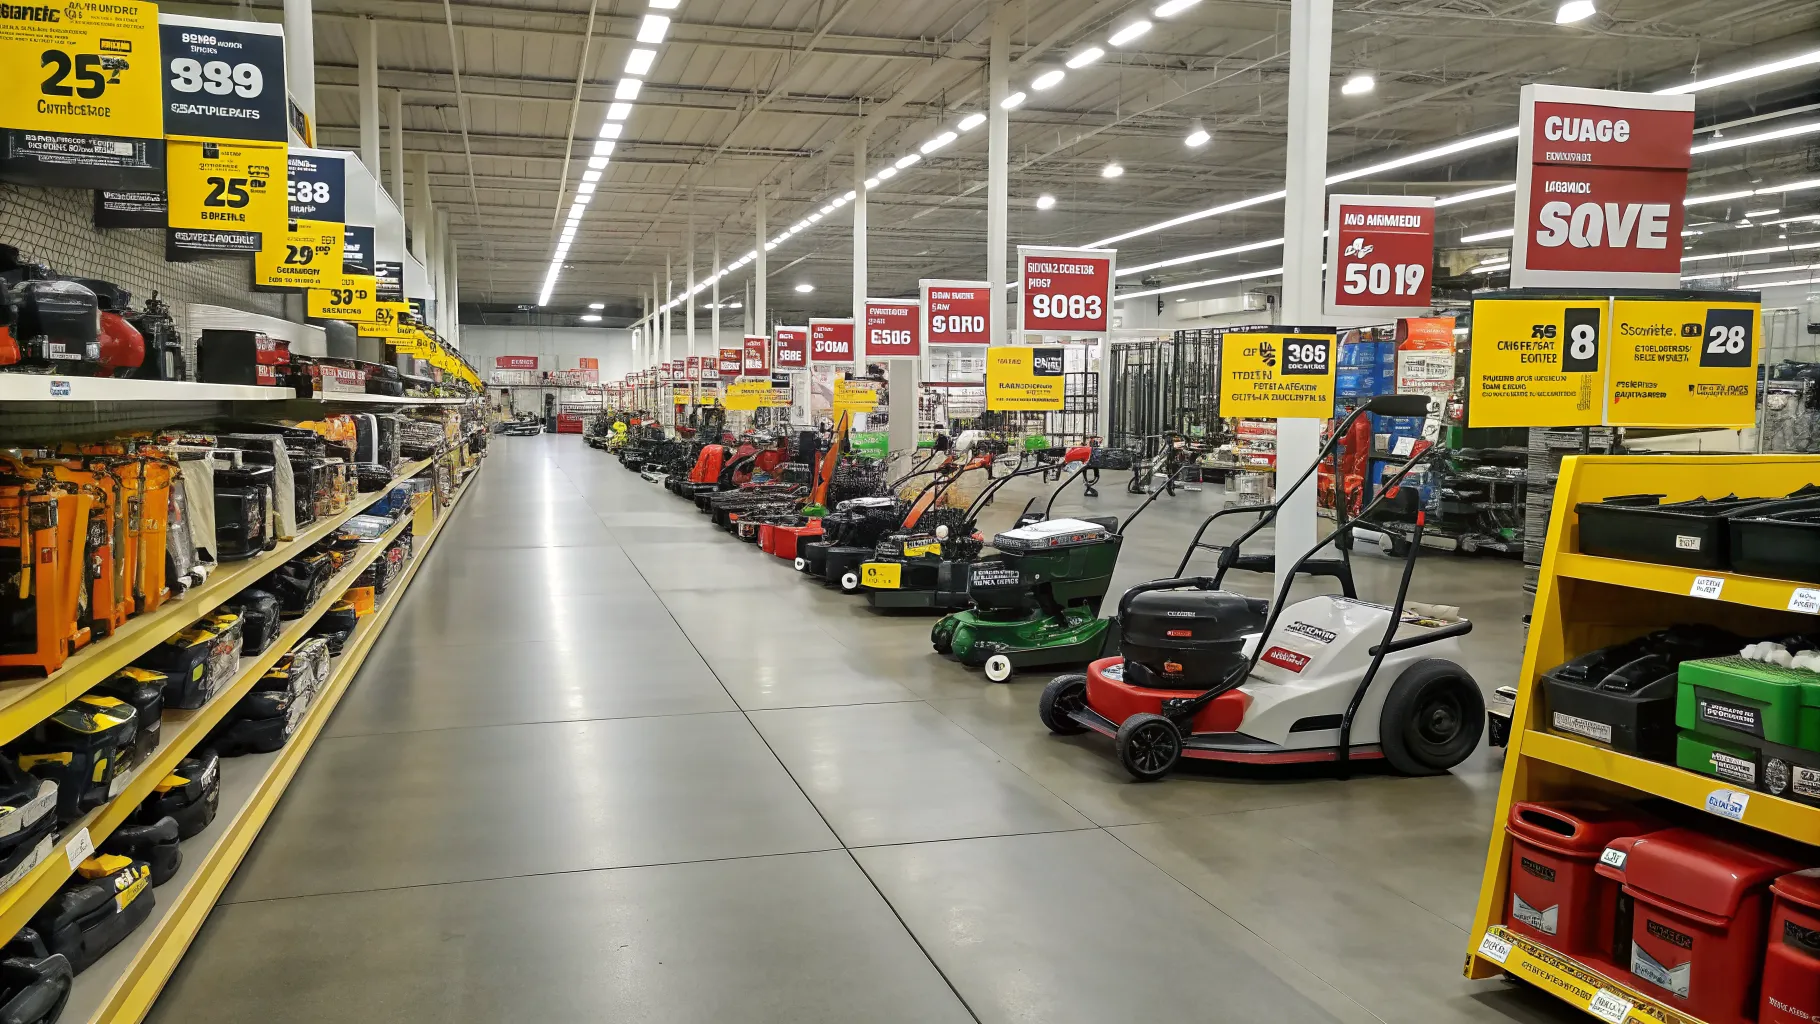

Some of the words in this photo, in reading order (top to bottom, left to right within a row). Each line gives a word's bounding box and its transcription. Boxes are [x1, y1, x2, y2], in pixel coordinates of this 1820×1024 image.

[41, 50, 105, 99] 25
[204, 176, 250, 208] 25
[1570, 324, 1595, 360] 8
[1706, 325, 1746, 354] 28
